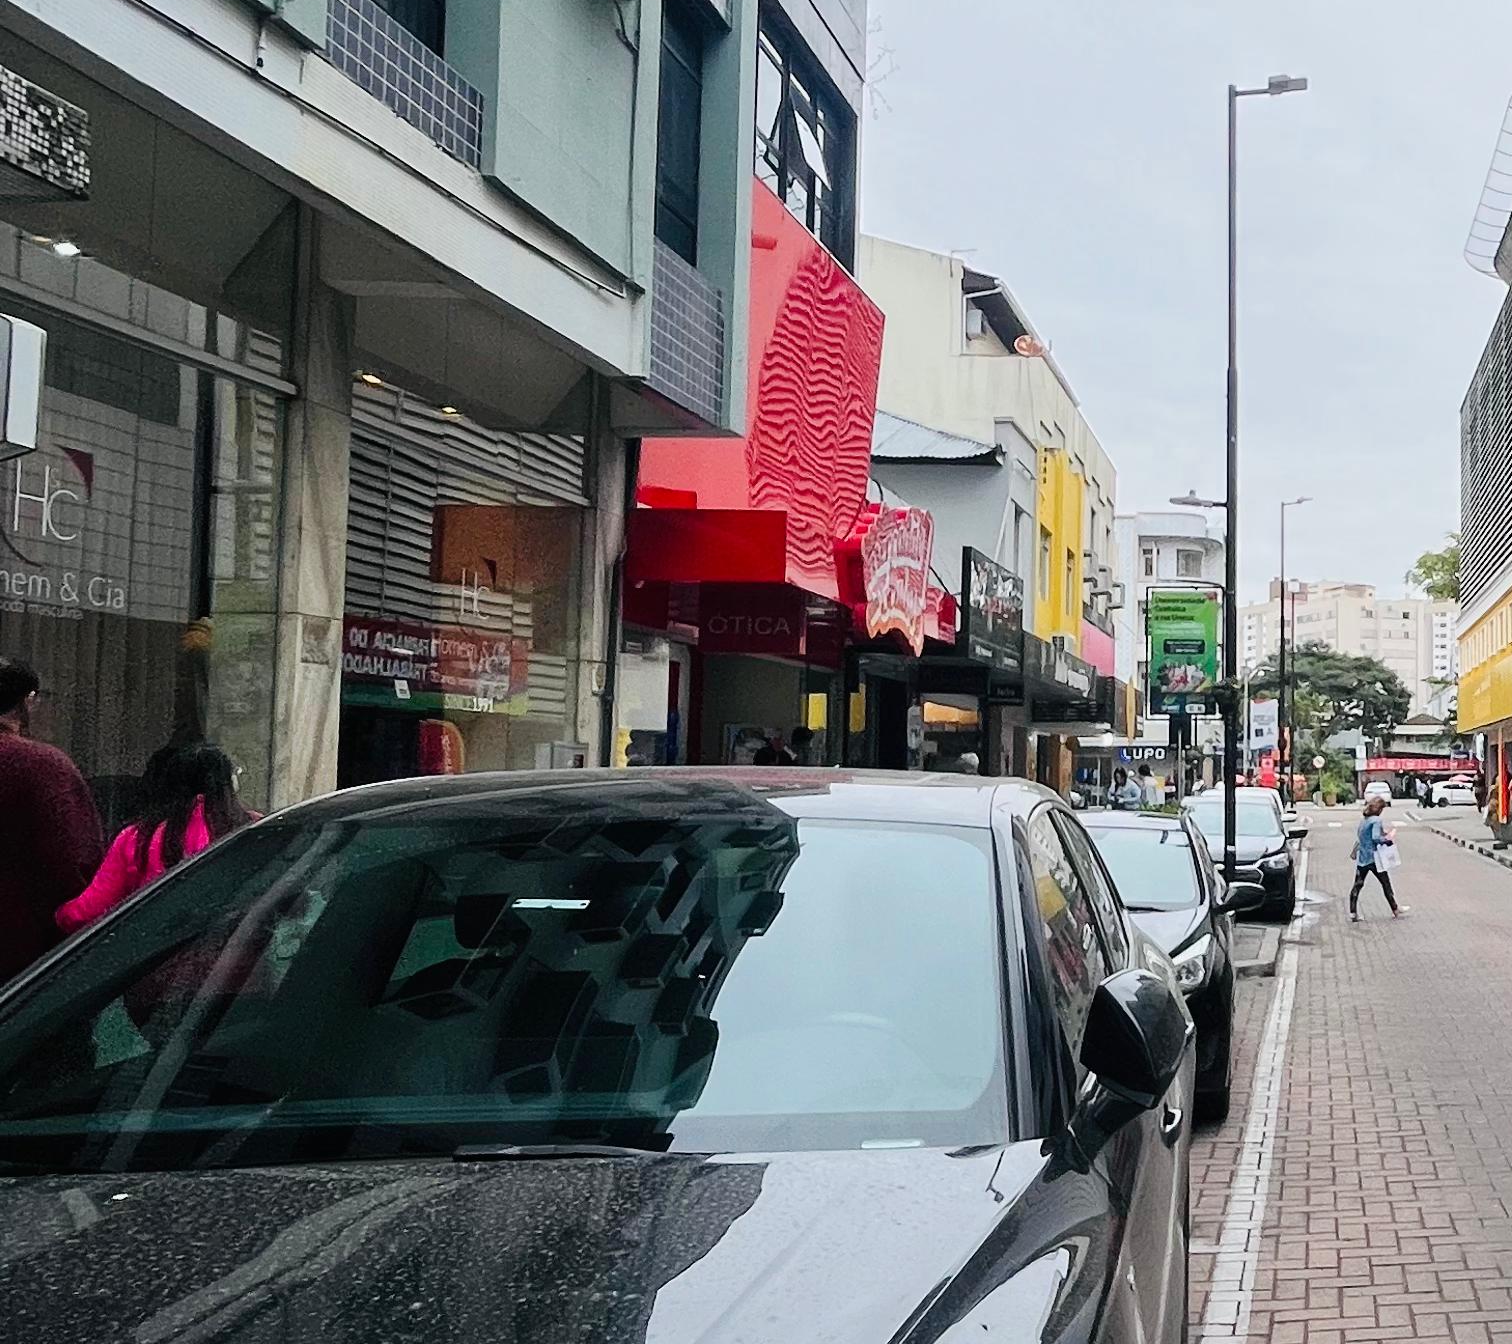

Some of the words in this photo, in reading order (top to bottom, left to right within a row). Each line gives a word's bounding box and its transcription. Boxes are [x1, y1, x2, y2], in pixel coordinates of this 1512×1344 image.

[60, 572, 80, 603] &
[87, 576, 125, 609] Cia
[1121, 747, 1166, 760] LUPO
